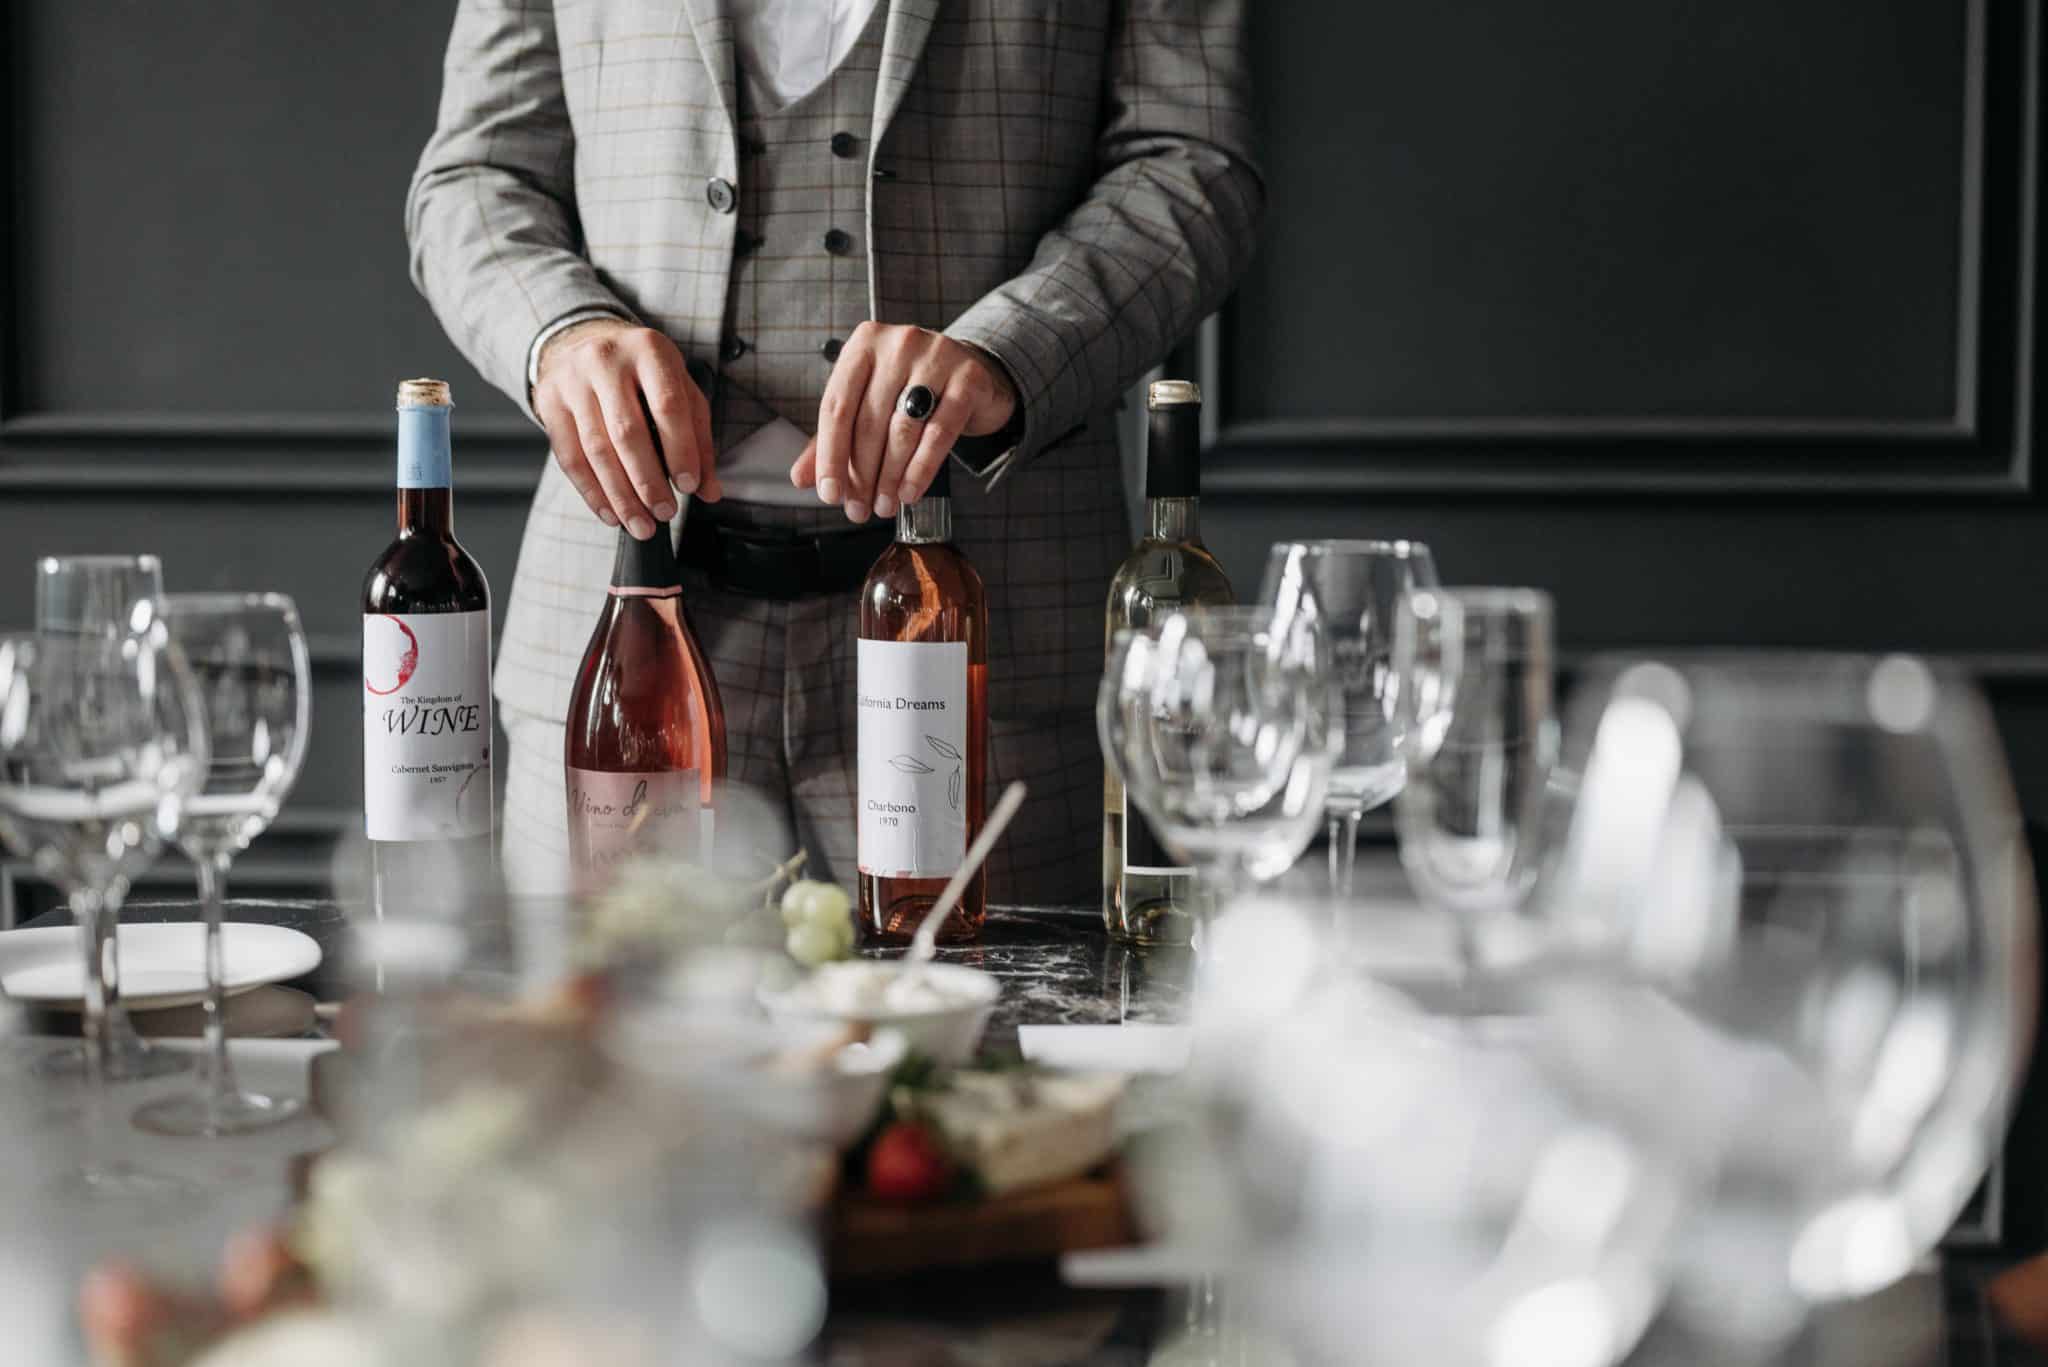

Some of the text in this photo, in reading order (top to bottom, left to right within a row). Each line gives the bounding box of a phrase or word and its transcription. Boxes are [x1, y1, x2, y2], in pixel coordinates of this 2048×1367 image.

[400, 693, 462, 704] The Kingdom of
[896, 697, 945, 711] Dreams
[383, 704, 479, 735] WINE
[392, 763, 430, 773] Cabernet
[571, 788, 616, 816] Vino
[867, 800, 916, 813] Charbono
